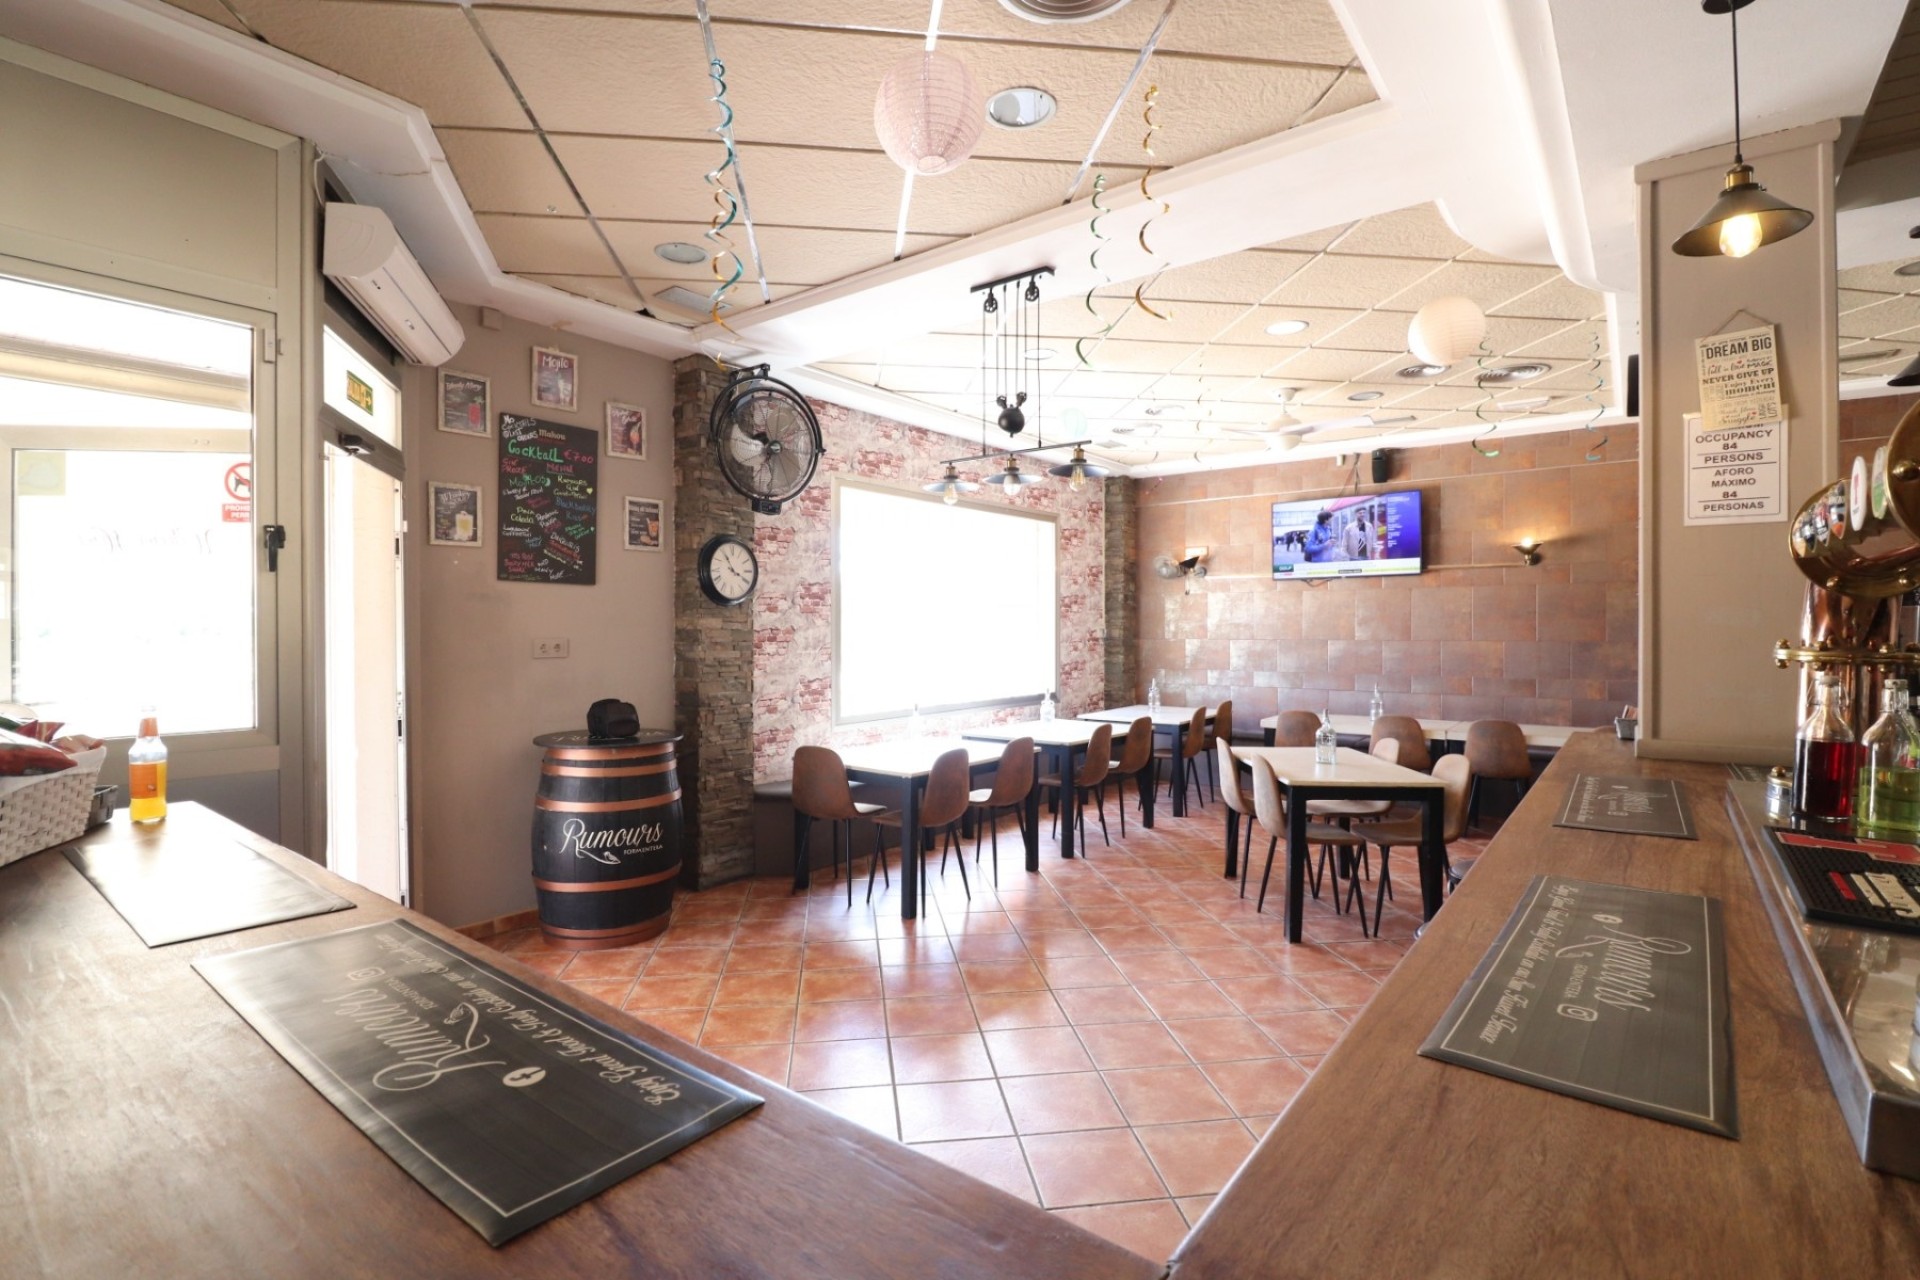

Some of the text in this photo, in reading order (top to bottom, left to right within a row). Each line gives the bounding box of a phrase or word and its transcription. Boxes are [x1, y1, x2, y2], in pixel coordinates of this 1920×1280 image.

[1706, 341, 1748, 359] DREAM
[1752, 336, 1772, 352] BIG
[1702, 367, 1774, 385] NEVER GIVE UP
[538, 429, 567, 441] Mahou
[1695, 429, 1773, 444] OCCUPANCY
[1704, 451, 1764, 464] PERSONS
[1722, 442, 1738, 451] 84
[1714, 466, 1754, 477] AFORO
[1722, 491, 1738, 499] 84
[1703, 501, 1764, 512] PERSONAS
[559, 818, 664, 865] Rumours
[1555, 925, 1692, 1012] Rumours
[462, 988, 516, 1014] Cocktails
[503, 1009, 548, 1031] Tasty
[322, 988, 507, 1091] Rumours
[544, 1035, 596, 1057] Food
[579, 1054, 648, 1084] Great
[632, 1075, 681, 1106] Enjoy
